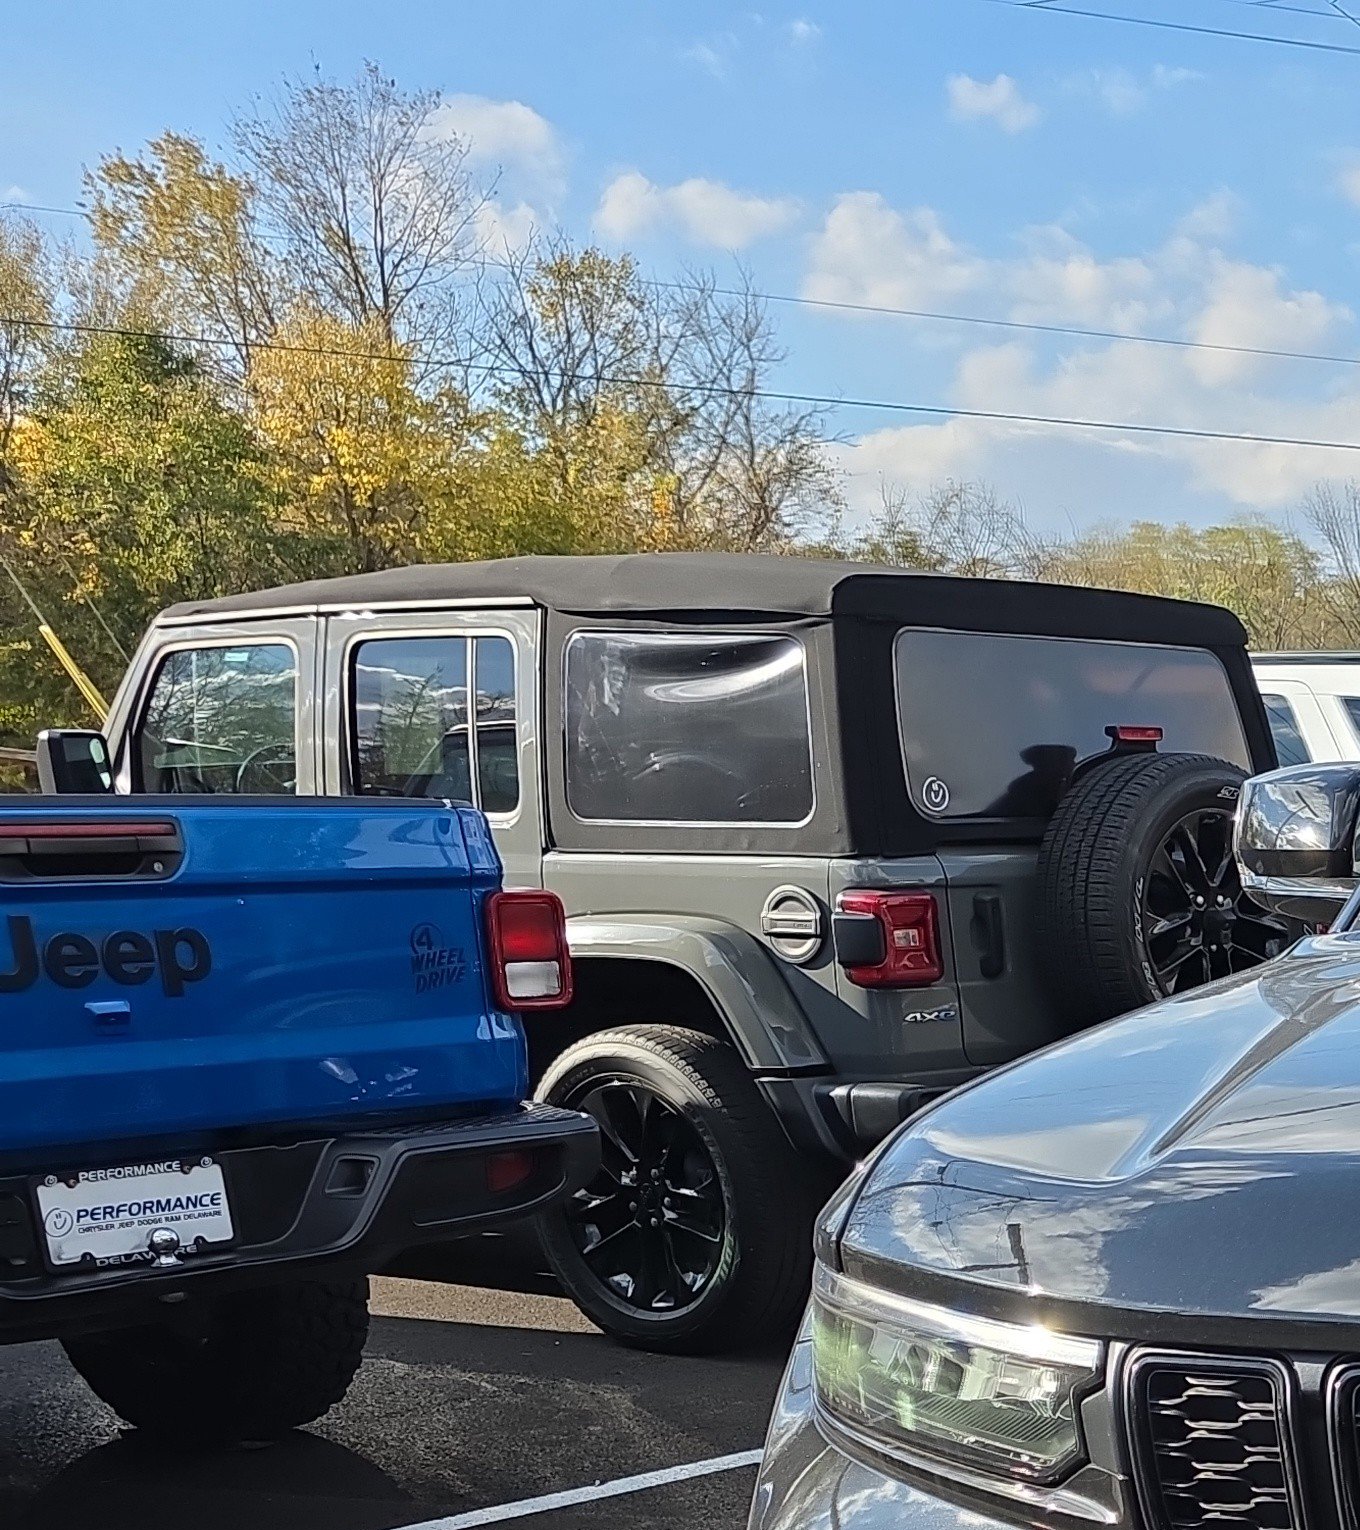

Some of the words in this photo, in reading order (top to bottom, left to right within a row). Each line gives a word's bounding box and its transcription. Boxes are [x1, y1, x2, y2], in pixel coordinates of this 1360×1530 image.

[0, 914, 213, 998] Jeep
[410, 948, 466, 975] WHEEL
[415, 966, 466, 996] DRIVE
[78, 1160, 181, 1182] PERFORMANCE
[76, 1192, 222, 1224] PERFORMANCE
[78, 1224, 115, 1234] CHRYSLER
[117, 1221, 135, 1230] JEEP
[137, 1218, 163, 1227] DODGE
[164, 1214, 181, 1223] RAM
[183, 1210, 222, 1221] DELAWARE
[95, 1244, 198, 1267] DELAWRE
